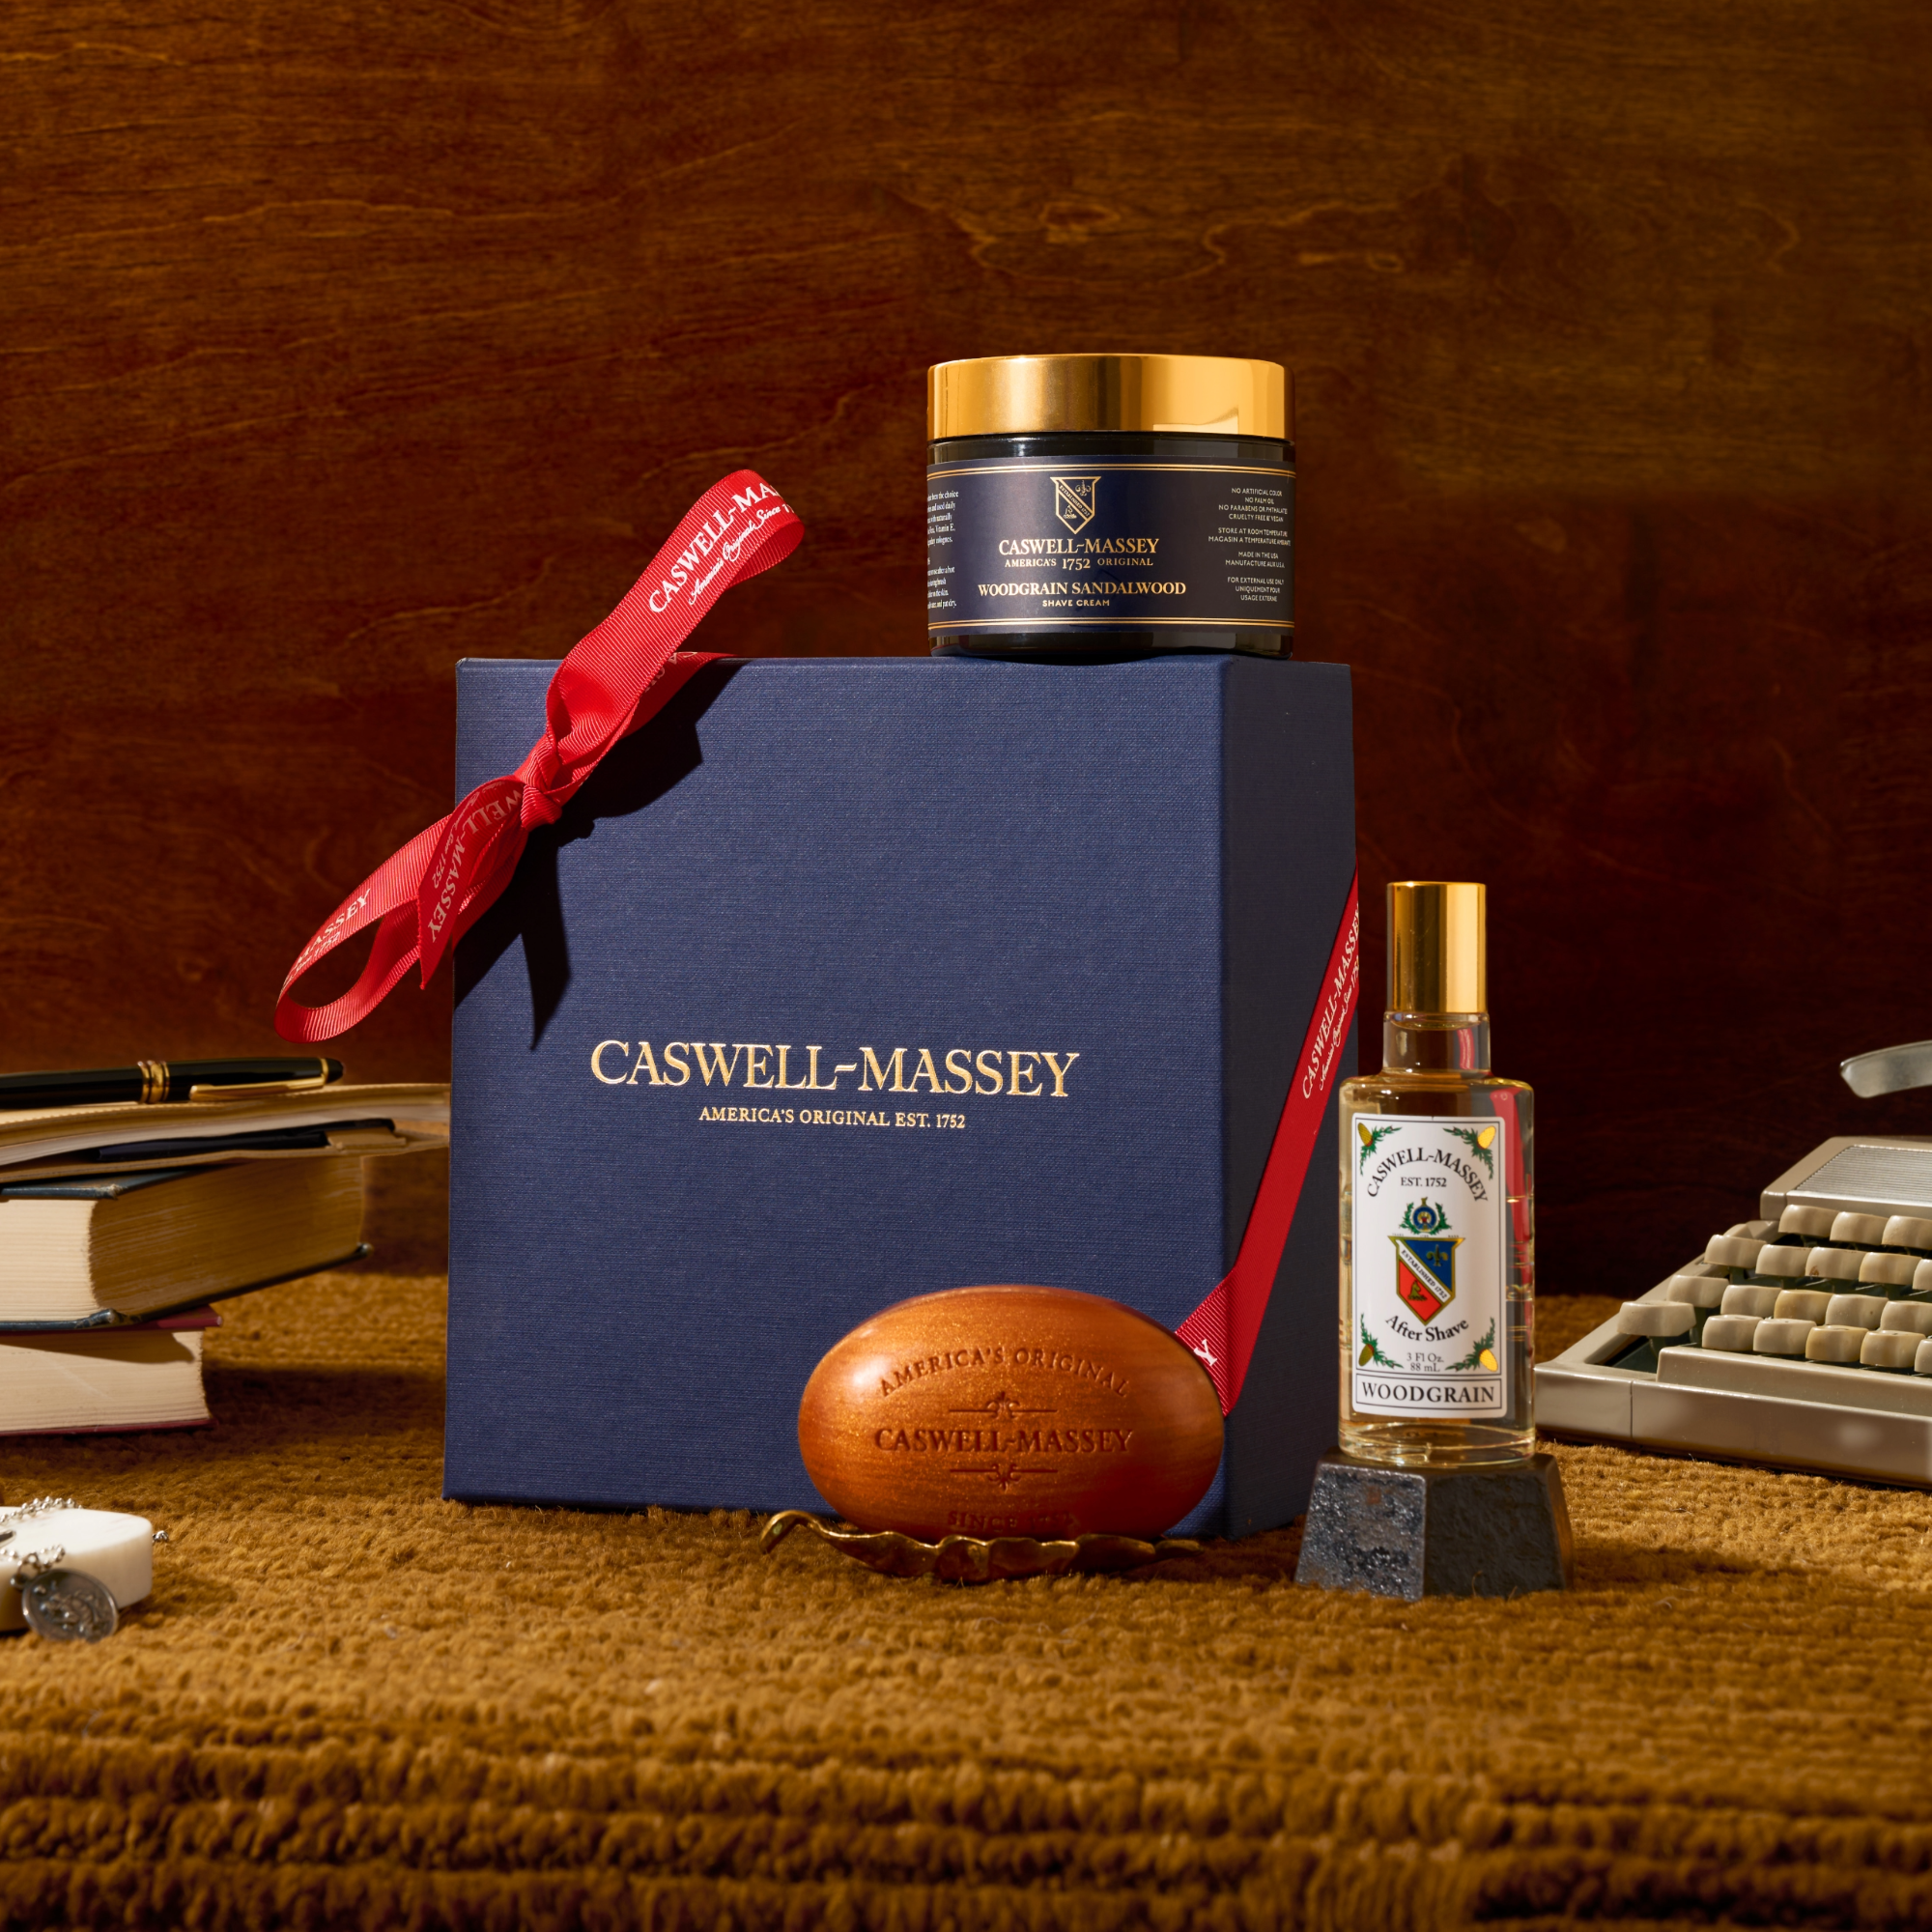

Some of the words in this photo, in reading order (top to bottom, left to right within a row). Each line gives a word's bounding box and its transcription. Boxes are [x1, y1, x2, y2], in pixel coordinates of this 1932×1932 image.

[648, 482, 783, 613] CASWELL-MA
[998, 538, 1159, 555] CASWELL-MASSEY
[1005, 558, 1057, 567] AMERICA'S
[1062, 557, 1092, 571] 1752
[1097, 557, 1153, 566] ORIGINAL
[978, 582, 1068, 596] WOODGRAIN
[1071, 582, 1187, 595] SANDALWOOD
[1042, 599, 1073, 608] SHAVE
[589, 1039, 1080, 1097] CASWELL-MASSEY
[698, 1107, 794, 1123] AMERICA'S
[799, 1109, 891, 1126] ORIGINAL
[895, 1112, 931, 1128] EST.
[936, 1114, 966, 1129] 1752
[1367, 1147, 1489, 1203] CASWELL-MASSEY
[1401, 1177, 1424, 1187] EST.
[1425, 1177, 1448, 1188] 1752
[1384, 1315, 1423, 1342] After
[1424, 1320, 1469, 1343] Shave
[1406, 1352, 1412, 1362] 3
[1410, 1362, 1422, 1372] 88
[1424, 1362, 1440, 1373] mL
[879, 1346, 1007, 1399] AMERICA'S
[1014, 1347, 1131, 1399] ORIGINAL
[1361, 1381, 1495, 1404] WOODGRAIN
[873, 1427, 1134, 1454] CASWELL-MASSEY
